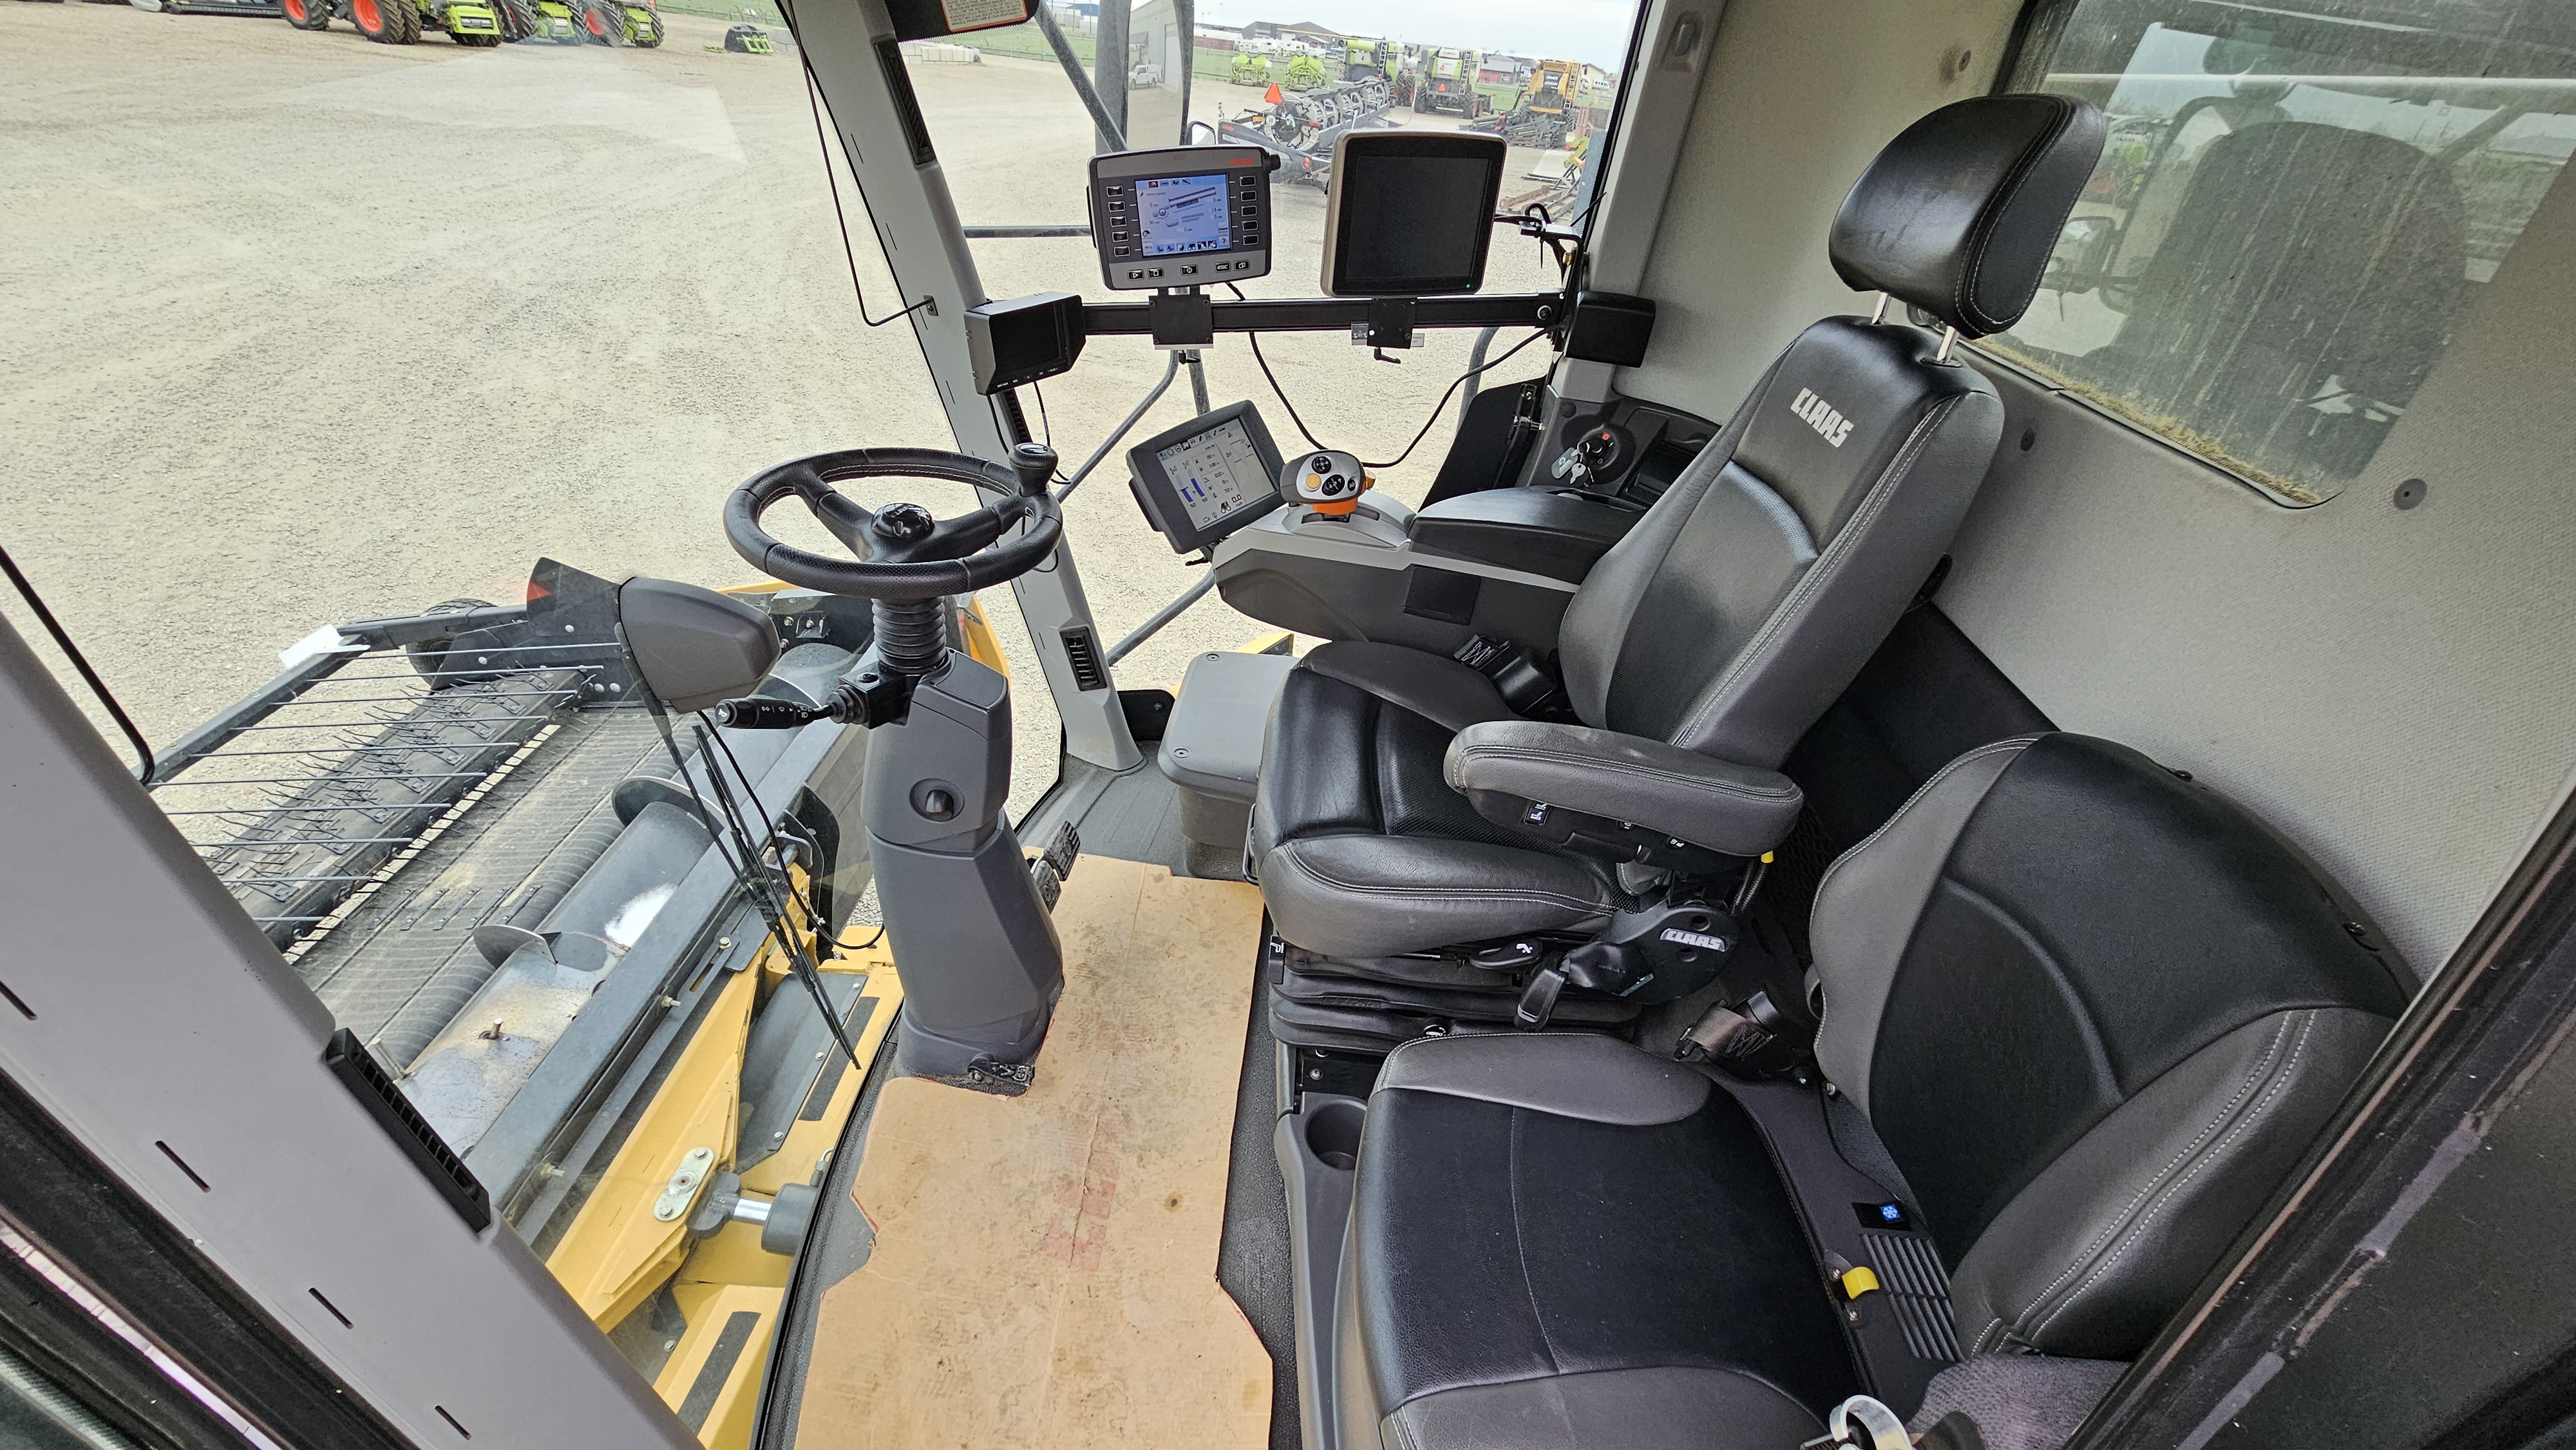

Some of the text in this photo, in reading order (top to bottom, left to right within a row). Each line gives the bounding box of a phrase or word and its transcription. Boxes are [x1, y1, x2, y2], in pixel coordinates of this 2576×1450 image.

[1790, 388, 1855, 448] CLAAS
[1231, 494, 1242, 502] 0.0
[1665, 930, 1722, 950] CLAAS
